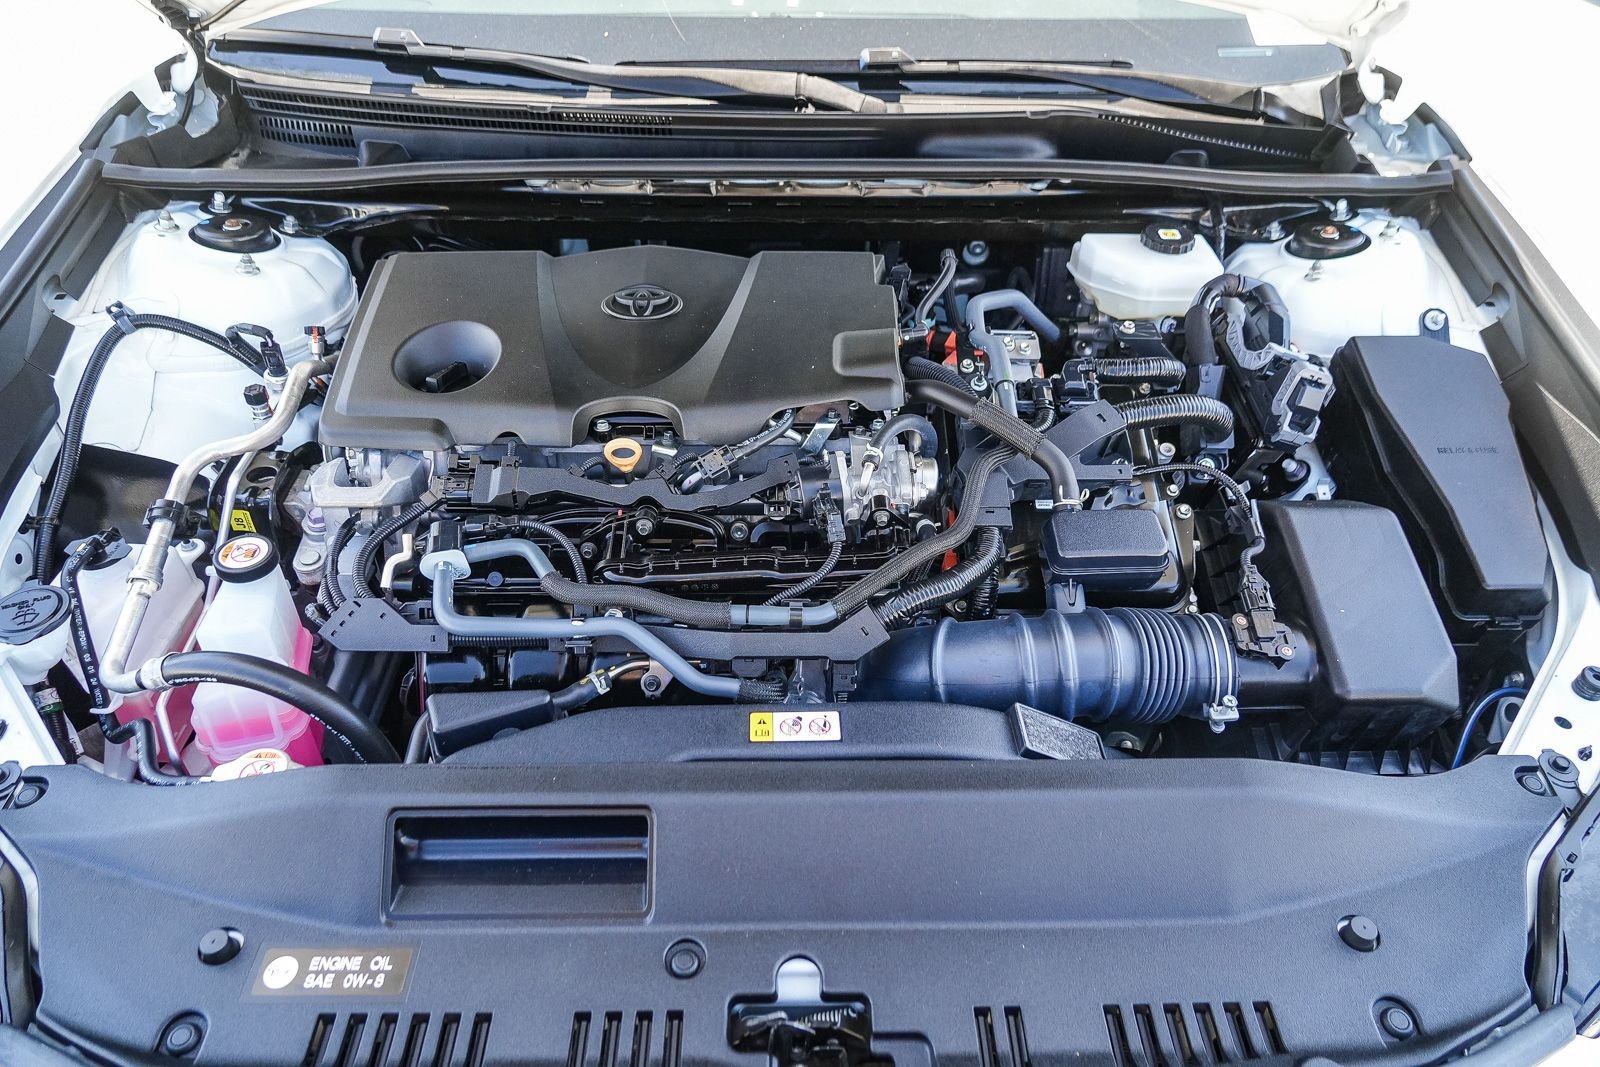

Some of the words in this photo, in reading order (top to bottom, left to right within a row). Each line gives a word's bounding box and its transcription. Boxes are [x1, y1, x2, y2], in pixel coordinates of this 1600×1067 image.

[308, 955, 363, 971] ENGINE
[369, 955, 393, 971] OIL
[303, 973, 335, 989] SAE
